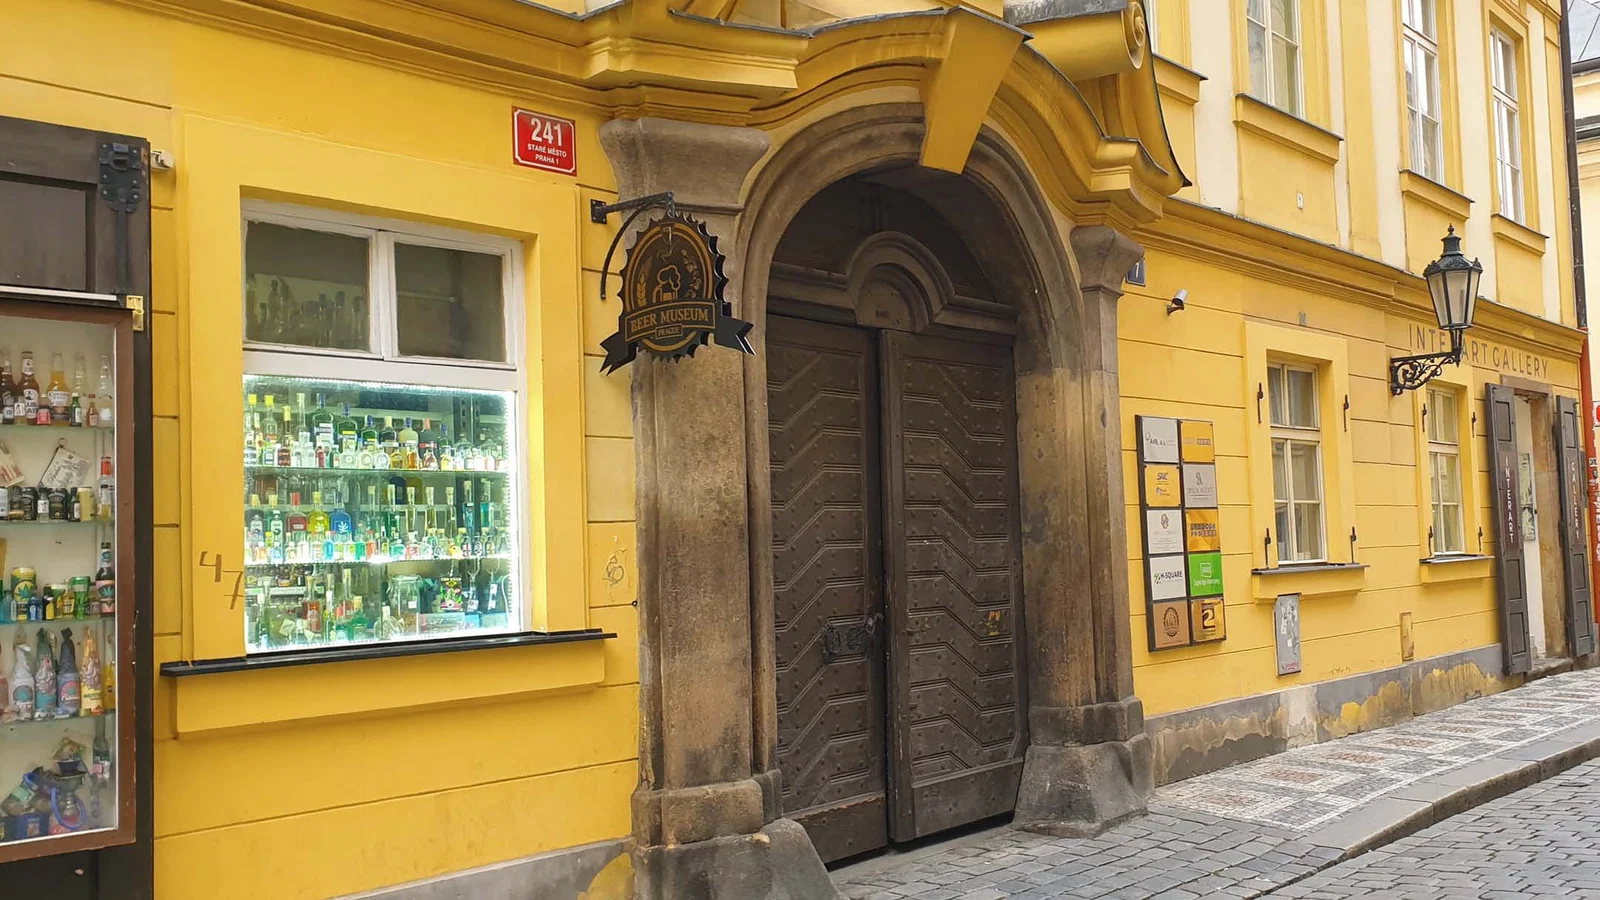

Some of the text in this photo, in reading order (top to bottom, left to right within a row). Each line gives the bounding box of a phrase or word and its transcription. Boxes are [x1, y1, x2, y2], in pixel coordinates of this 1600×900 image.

[531, 117, 563, 147] 241
[535, 153, 555, 164] PRAHA
[630, 307, 709, 332] BEER MUSEUM
[657, 326, 680, 337] PRAGUE
[1492, 346, 1549, 379] GALLERY
[1505, 455, 1514, 544] INTERART
[1571, 461, 1580, 539] GALLERY
